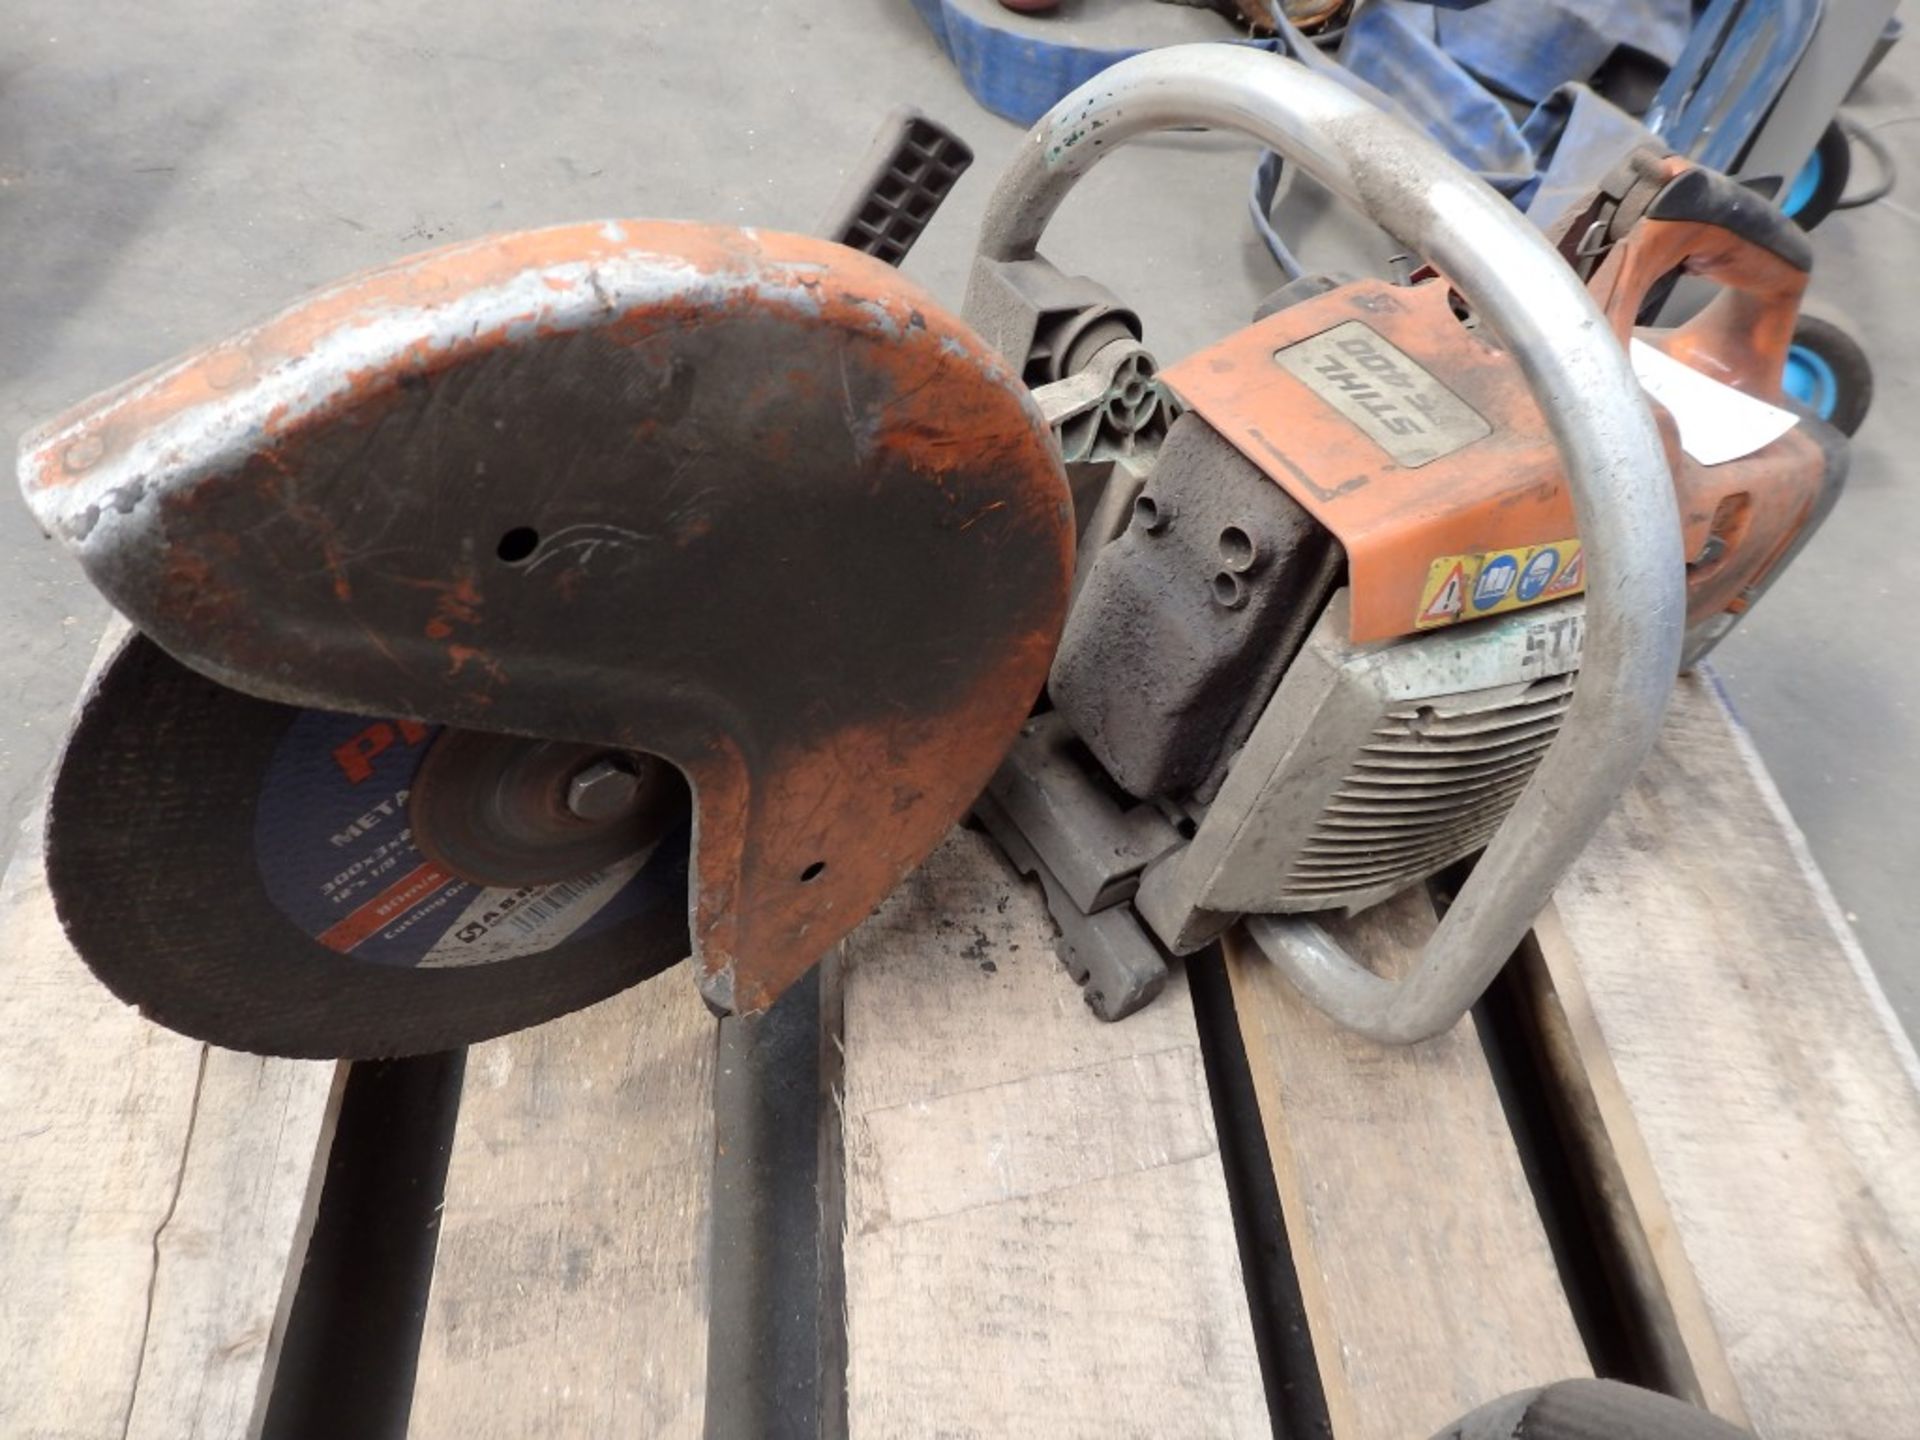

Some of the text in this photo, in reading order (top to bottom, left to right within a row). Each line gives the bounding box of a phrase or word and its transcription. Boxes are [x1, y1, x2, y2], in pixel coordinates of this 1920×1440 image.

[1336, 338, 1415, 389] 400
[1315, 354, 1427, 436] STIHL
[383, 896, 448, 941] Cutting
